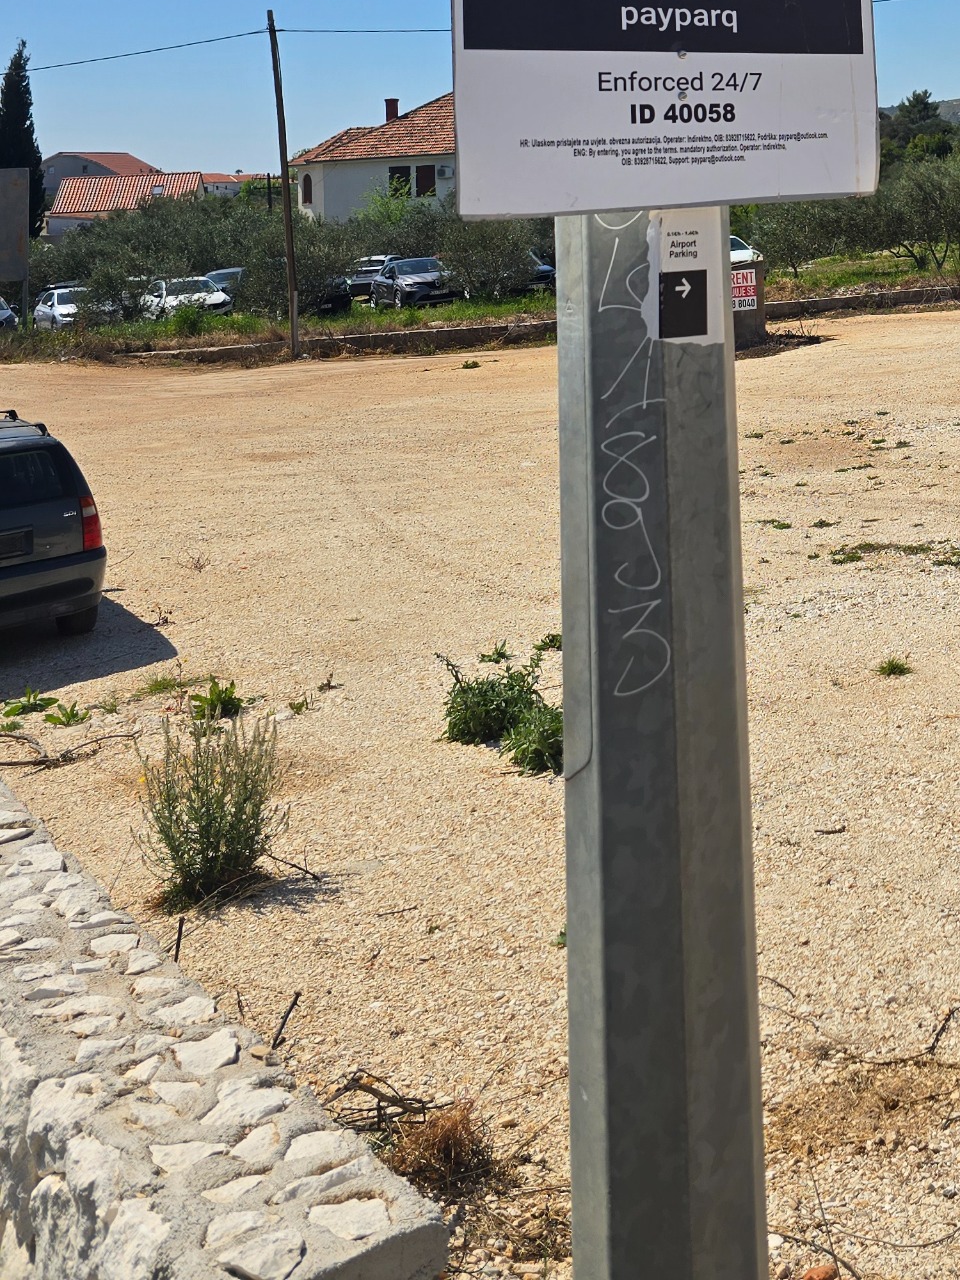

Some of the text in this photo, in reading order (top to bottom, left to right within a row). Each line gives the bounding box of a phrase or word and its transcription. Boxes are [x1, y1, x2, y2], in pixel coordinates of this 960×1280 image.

[622, 7, 737, 32] payparq
[599, 71, 762, 93] Enforced 24/7
[631, 103, 735, 124] ID 40058
[574, 148, 588, 157] ENG:
[589, 148, 596, 158] By
[621, 149, 631, 157] you
[632, 147, 646, 157] agree
[647, 146, 653, 154] to
[654, 146, 662, 154] the
[621, 157, 633, 166] OIB:
[670, 240, 697, 250] Airport
[669, 249, 698, 259] Parking
[731, 272, 754, 285] RENT
[747, 286, 755, 295] SE
[738, 298, 755, 308] 8040
